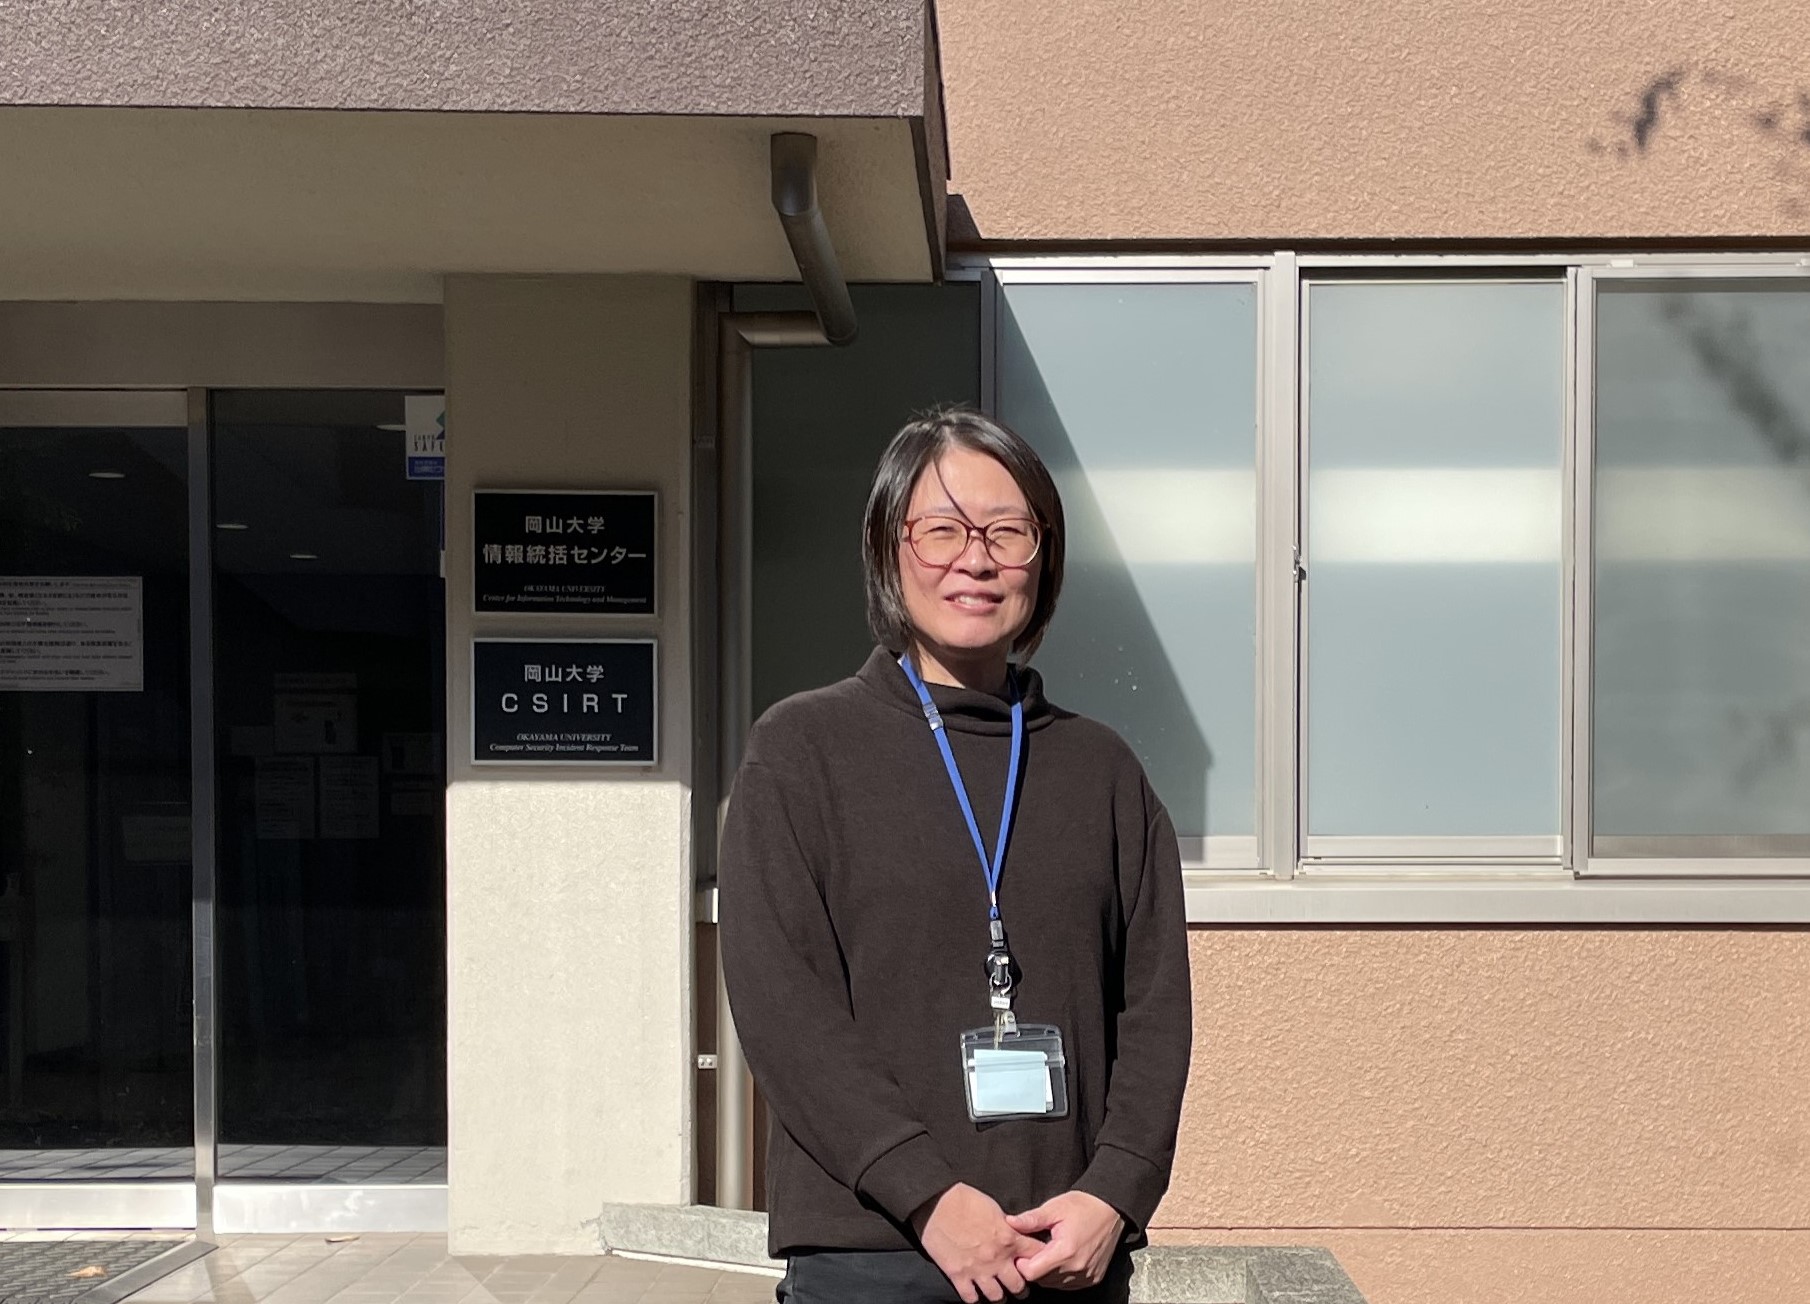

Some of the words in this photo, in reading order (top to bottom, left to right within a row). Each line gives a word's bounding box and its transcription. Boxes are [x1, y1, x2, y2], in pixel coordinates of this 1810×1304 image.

[525, 515, 605, 534] 岡山大学
[483, 543, 647, 565] 情報統括センター
[562, 585, 605, 593] UNIVERSITY
[483, 594, 504, 602] Center
[505, 594, 515, 603] for
[517, 594, 554, 603] Information
[556, 595, 591, 604] Technology
[592, 595, 605, 603] and
[606, 596, 647, 604] Management
[524, 664, 604, 683] 岡山大学
[501, 693, 628, 713] CSIRT
[516, 733, 558, 741] OKAYAMA
[560, 733, 612, 742] UNIVERSITY
[489, 743, 524, 752] Computer
[525, 743, 554, 752] Security
[556, 743, 585, 752] Incident
[586, 744, 619, 753] Response
[620, 744, 639, 752] Team
